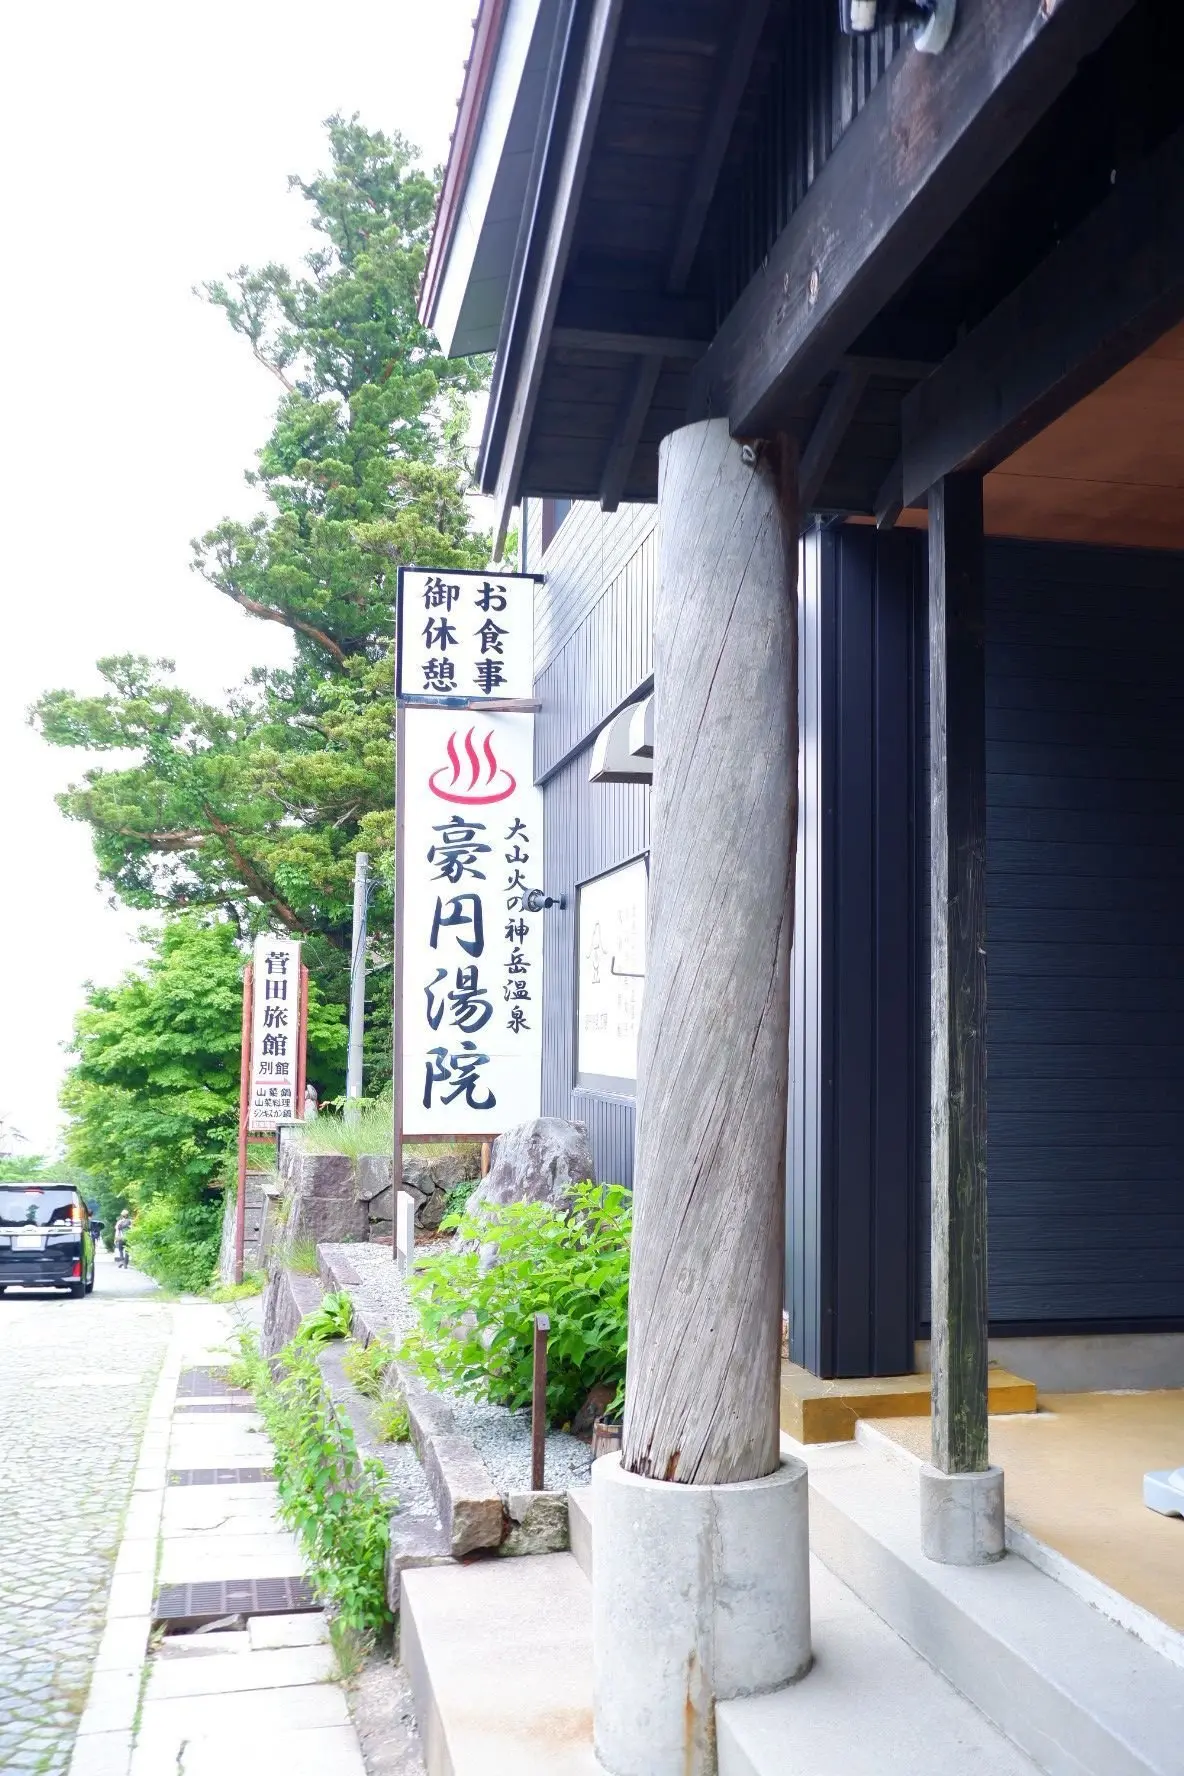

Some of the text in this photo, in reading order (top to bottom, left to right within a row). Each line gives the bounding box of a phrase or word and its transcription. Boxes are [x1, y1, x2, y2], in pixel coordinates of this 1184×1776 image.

[421, 576, 460, 693] 御休憩
[473, 581, 510, 695] お食事
[422, 815, 497, 1110] 豪円湯院
[503, 817, 532, 1034] 大山火の神岳温泉
[262, 951, 290, 1056] 菅田旅館
[258, 1061, 290, 1075] 別館
